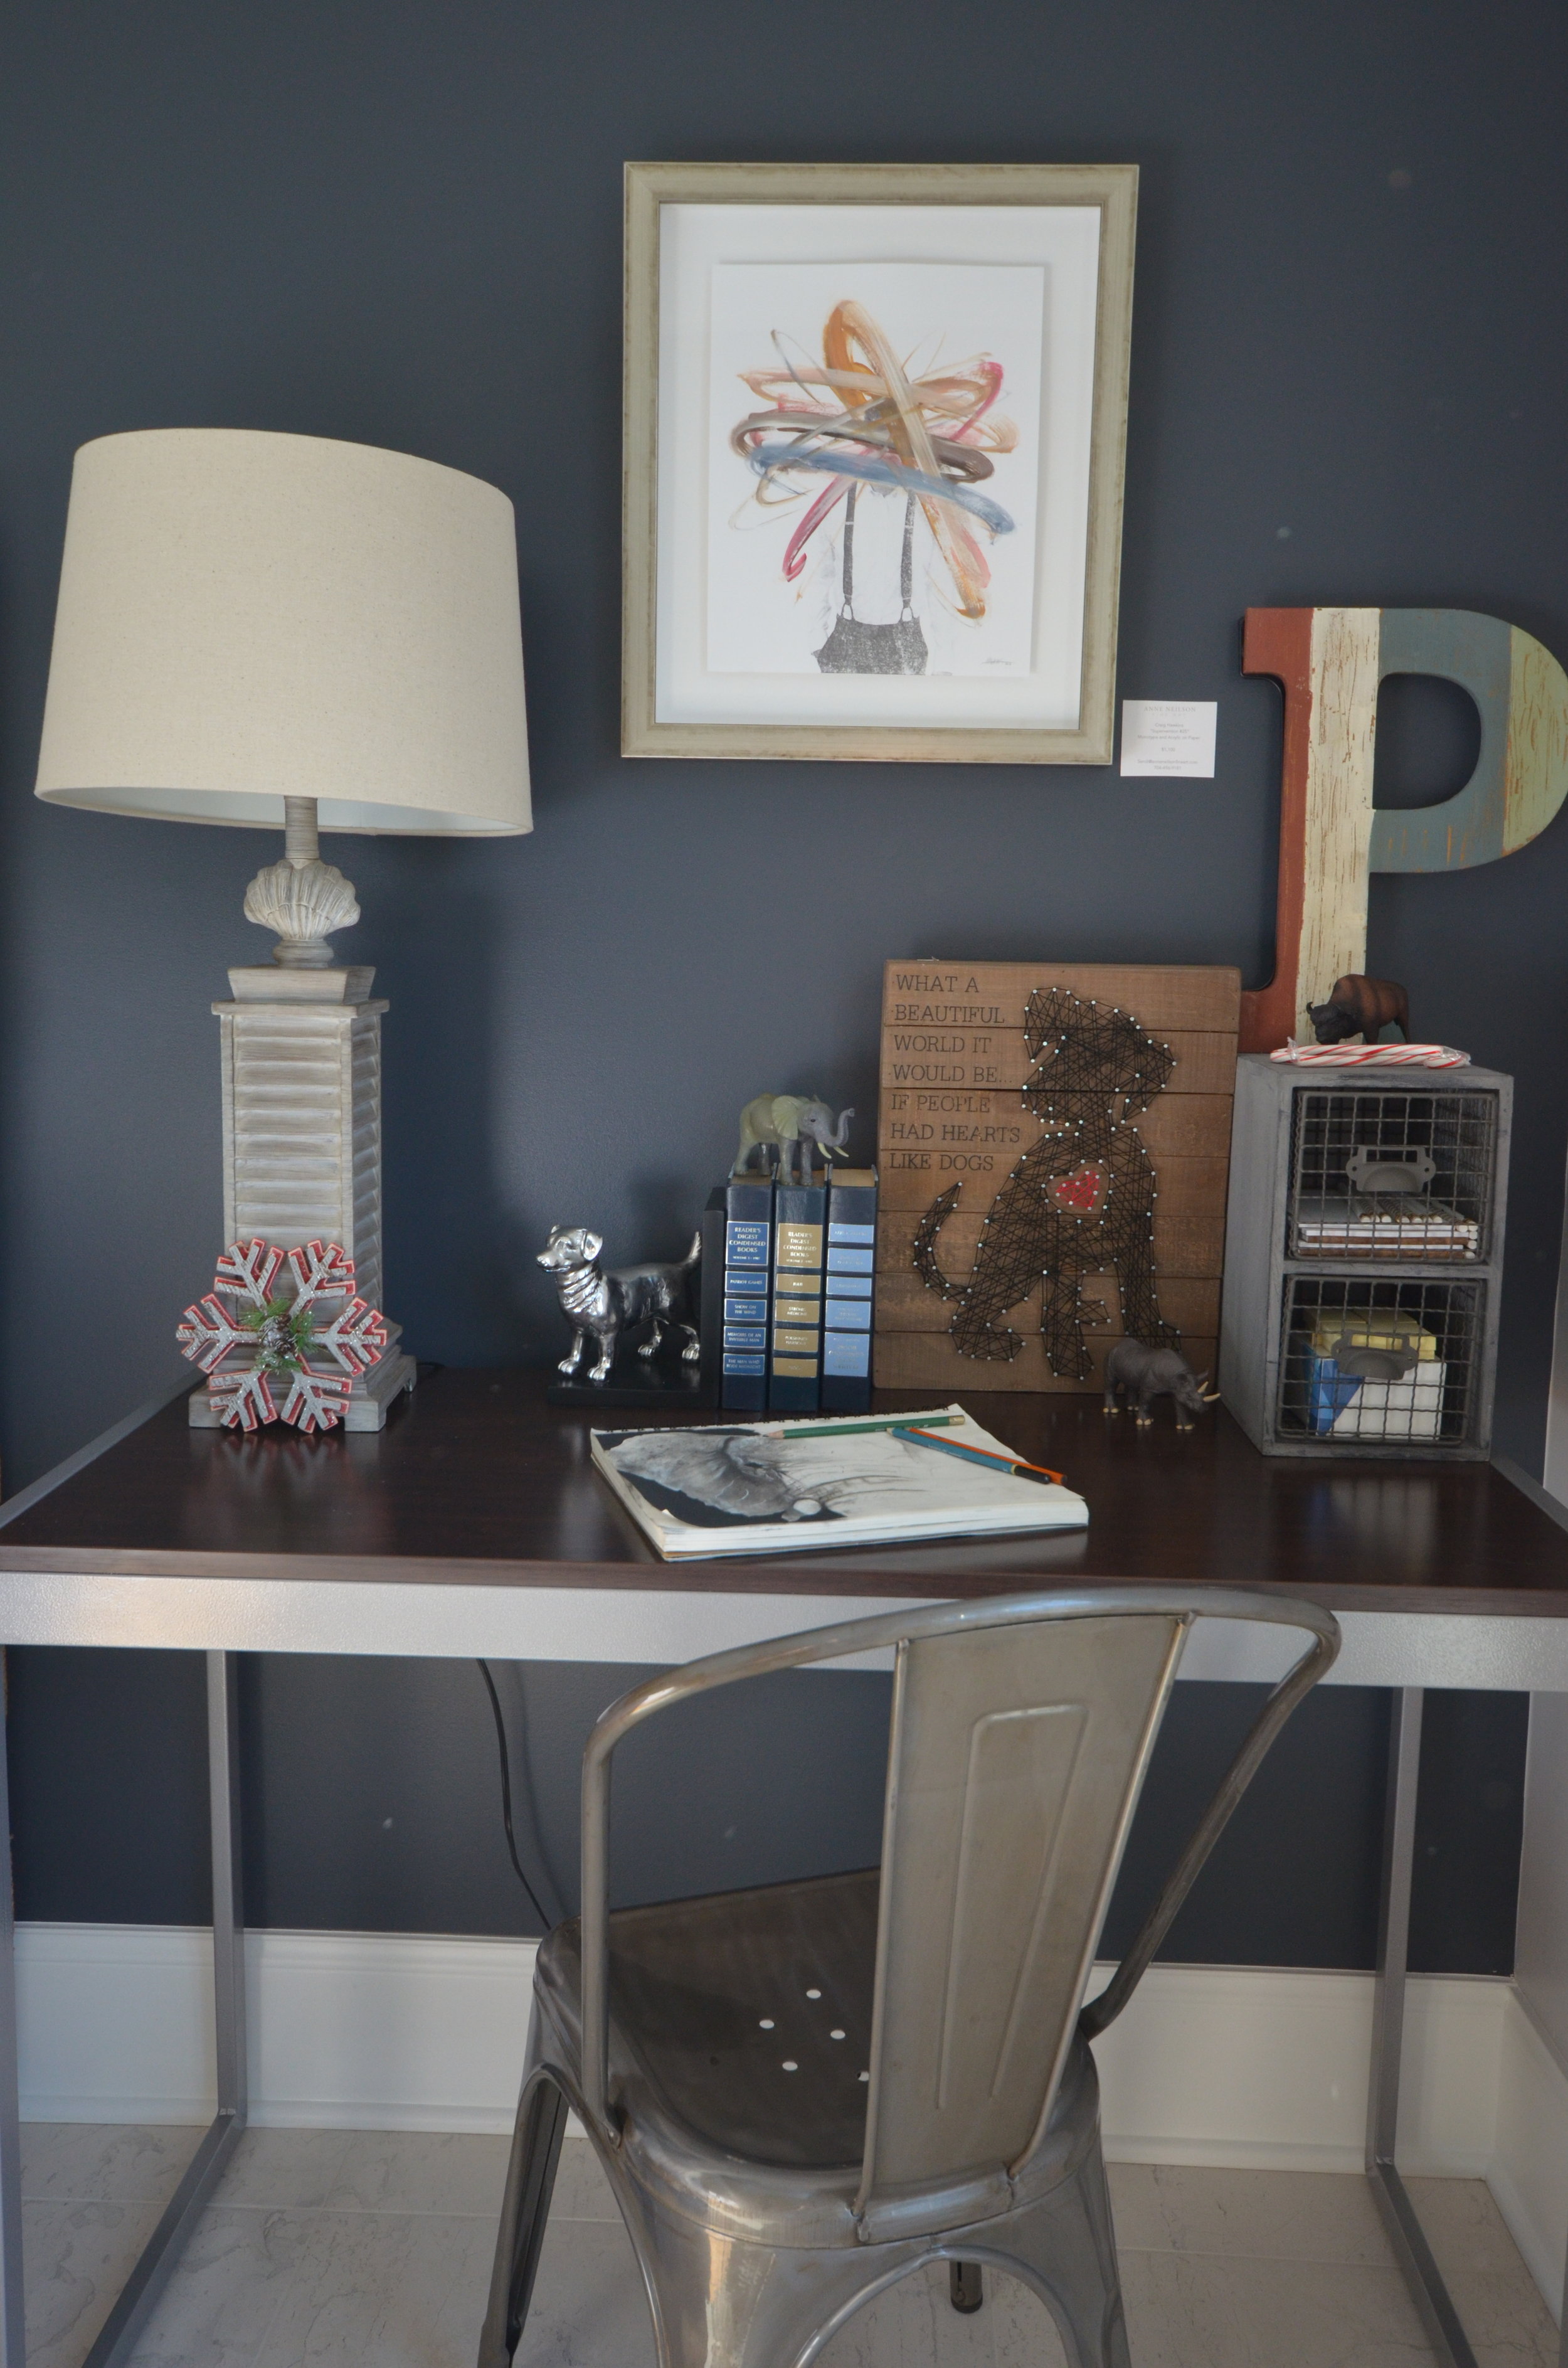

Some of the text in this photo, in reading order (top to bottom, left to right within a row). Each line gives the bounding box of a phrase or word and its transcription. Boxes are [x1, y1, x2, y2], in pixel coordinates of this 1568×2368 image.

[896, 974, 979, 992] WHAT A
[894, 1004, 1004, 1023] BEAUTIFUL
[894, 1035, 992, 1053] WORLD IT
[893, 1064, 965, 1081] WOULD
[891, 1094, 990, 1113] IF PEOPLE
[891, 1123, 1020, 1143] HAD HEARTS
[890, 1153, 993, 1171] LIKE DOGS
